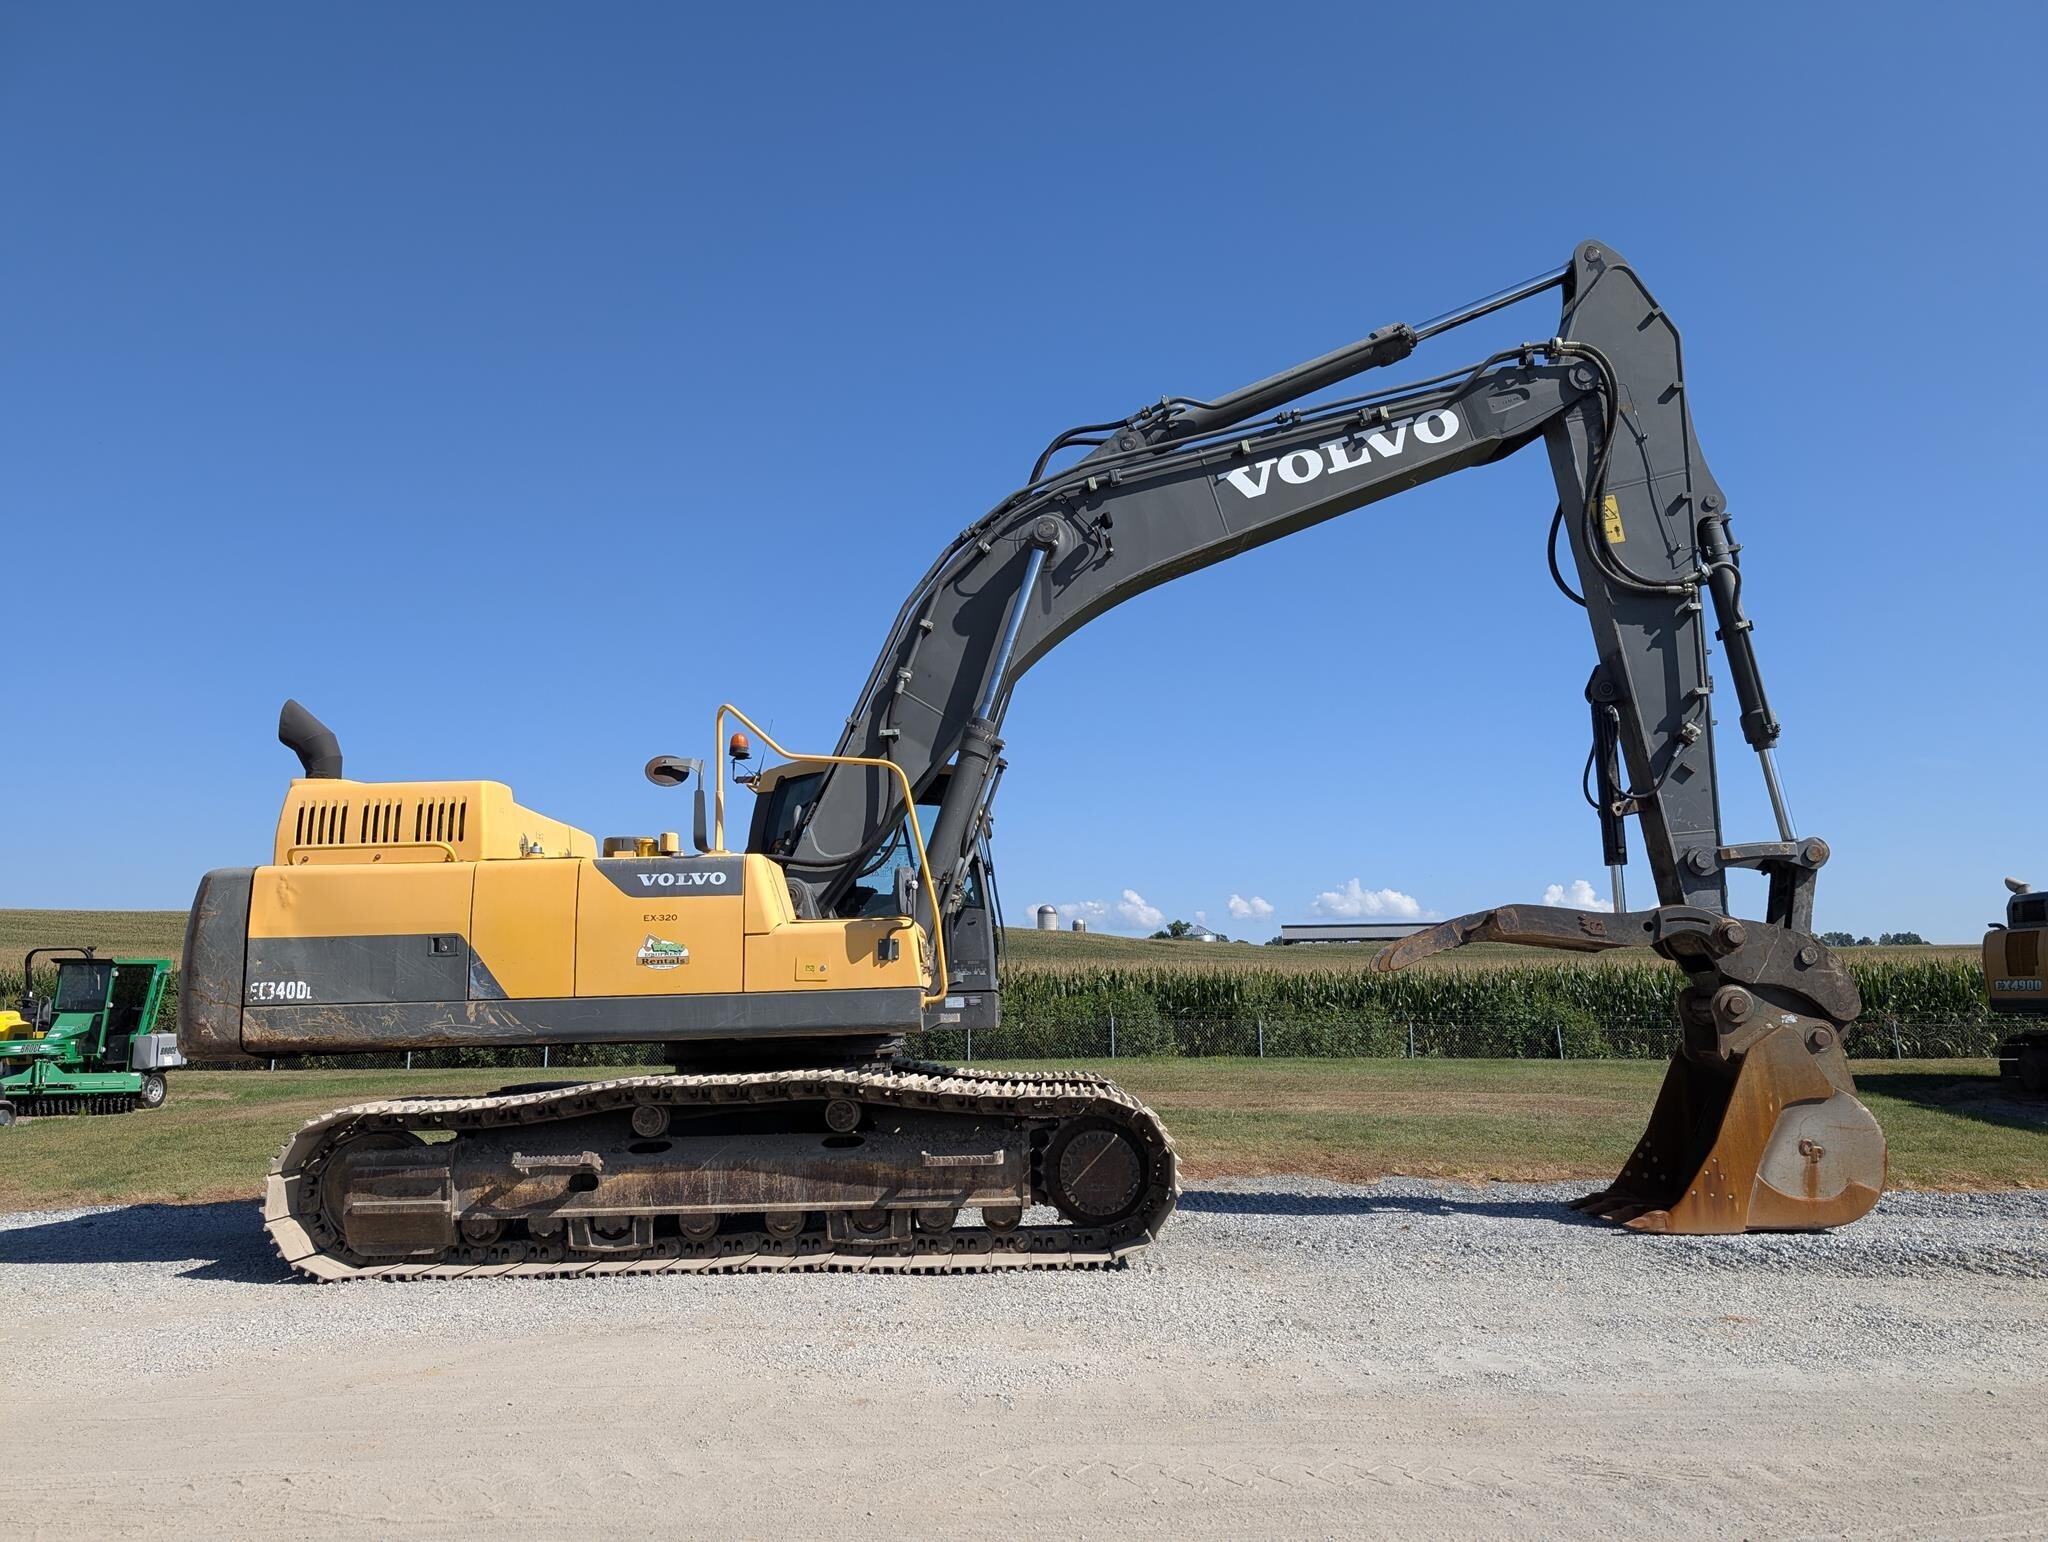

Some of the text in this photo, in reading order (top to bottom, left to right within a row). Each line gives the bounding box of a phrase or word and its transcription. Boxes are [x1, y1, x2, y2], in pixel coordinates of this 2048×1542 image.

[1217, 409, 1459, 499] VOLVO
[637, 872, 727, 886] VOLVO
[643, 914, 678, 922] EX-320
[641, 957, 686, 965] Rentals
